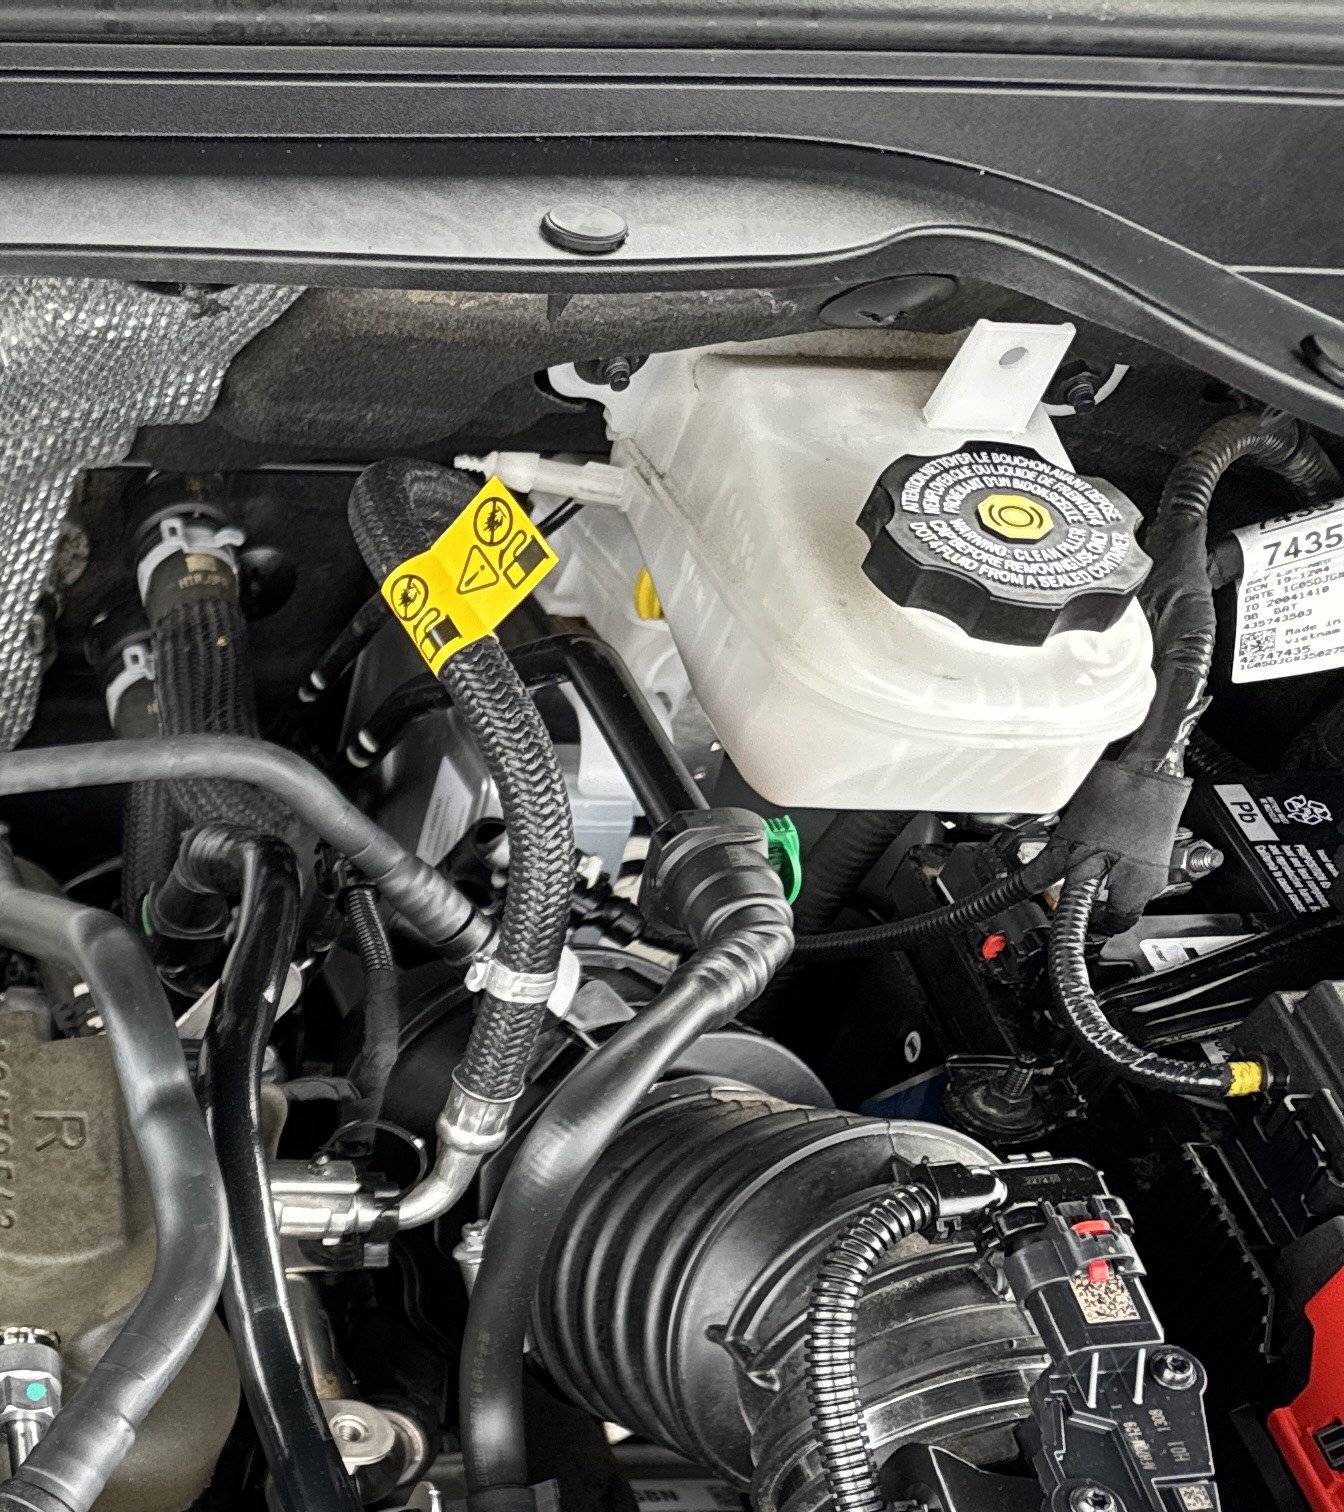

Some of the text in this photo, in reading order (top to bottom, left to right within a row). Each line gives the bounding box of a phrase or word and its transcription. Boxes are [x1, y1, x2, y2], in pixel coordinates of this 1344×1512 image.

[973, 452, 991, 463] LE
[991, 452, 1052, 474] BOUCHON
[972, 464, 991, 476] DU
[1037, 474, 1057, 488] DE
[929, 520, 957, 540] CAP
[948, 537, 1005, 569] BEFORE
[1013, 548, 1064, 562] CLEAN
[935, 545, 979, 571] FLUID
[978, 564, 1024, 585] FROM
[1026, 575, 1038, 588] A
[1037, 571, 1093, 588] SEALED
[1284, 618, 1342, 637] Made in
[1230, 801, 1259, 824] Pb
[33, 1109, 88, 1152] R
